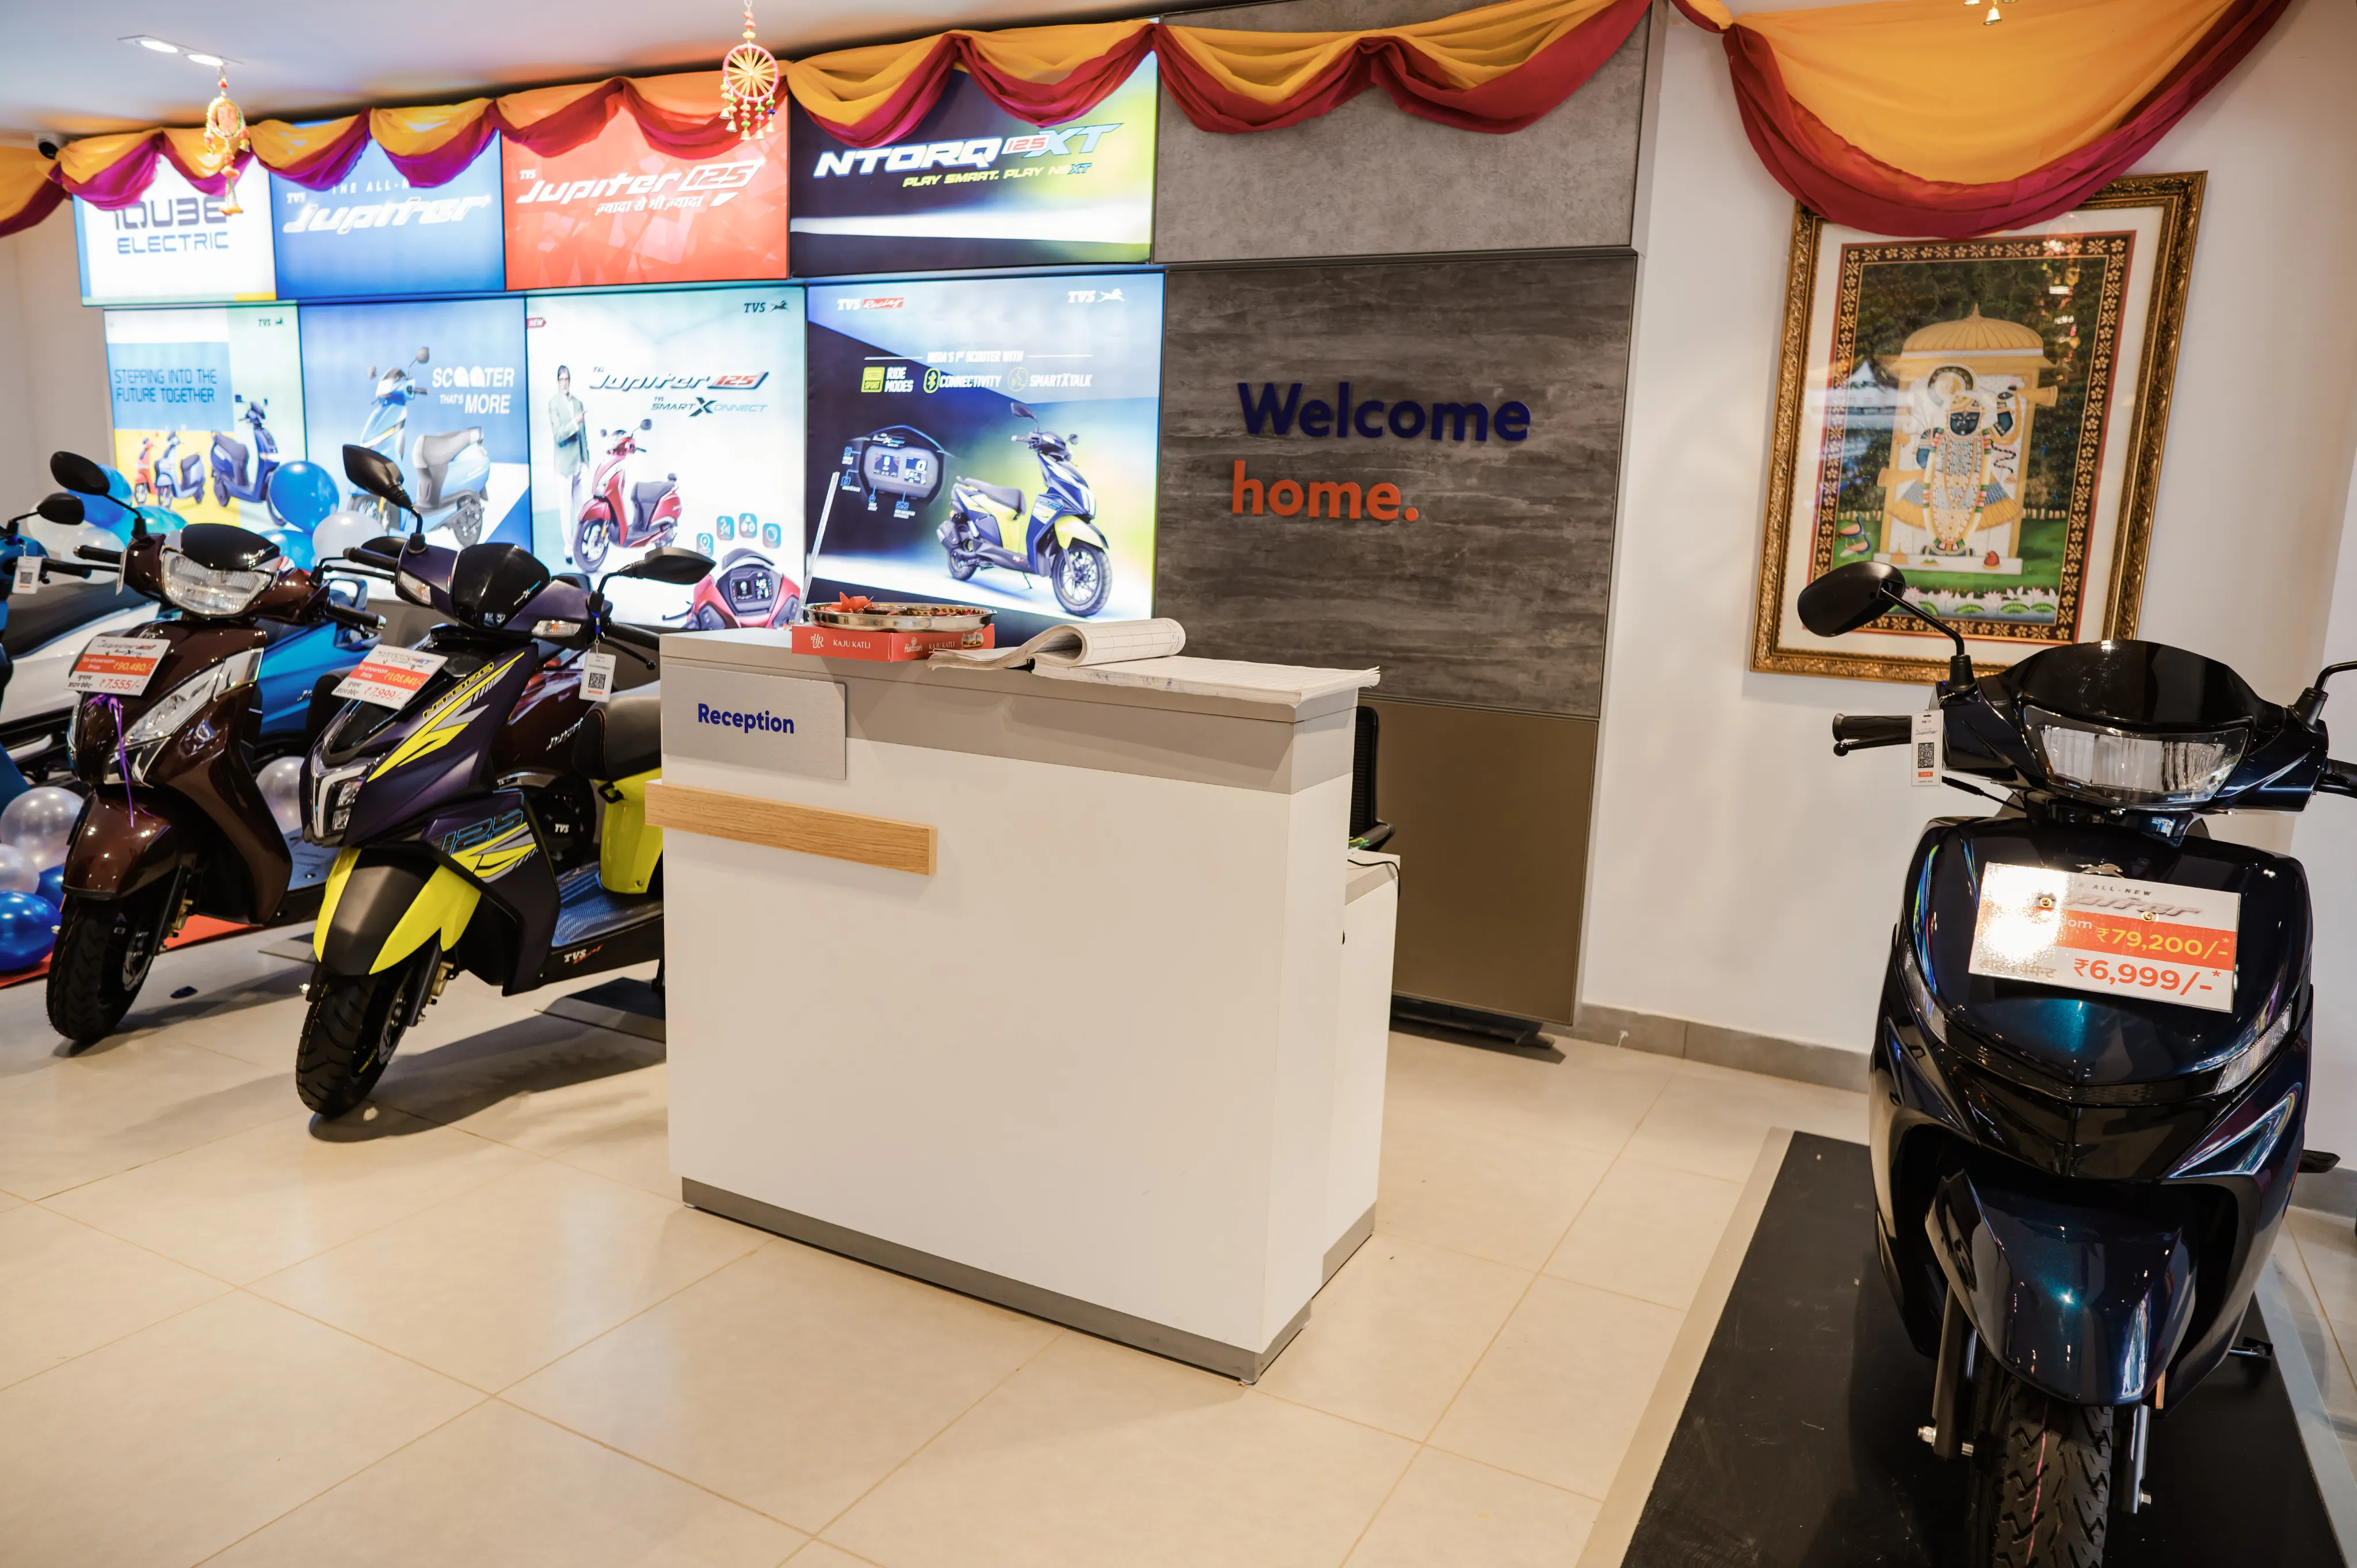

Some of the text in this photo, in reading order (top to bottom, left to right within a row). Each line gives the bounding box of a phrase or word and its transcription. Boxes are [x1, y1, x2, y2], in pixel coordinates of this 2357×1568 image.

[813, 136, 1003, 178] NTORQ
[1006, 138, 1047, 152] 125
[520, 169, 536, 180] TVS
[689, 163, 750, 186] 125
[902, 175, 942, 187] PLAY
[944, 170, 999, 184] SMART.
[1003, 167, 1044, 179] PLAY
[287, 192, 306, 203] TVS
[283, 196, 491, 234] Jupiter
[117, 231, 228, 254] ELECTRIC
[1067, 290, 1096, 303] TVS
[744, 302, 766, 313] TVS
[837, 299, 861, 310] TVS
[258, 319, 270, 327] TVS
[528, 319, 544, 327] NEW
[115, 369, 217, 384] STEPPING INTO THE
[432, 366, 514, 388] SCOOTER
[716, 375, 758, 386] 125
[886, 367, 907, 380] RIDE
[884, 380, 914, 392] MODES
[939, 375, 1002, 388] CONNECTIVITY
[116, 387, 215, 403] FUTURE TOGETHER
[440, 394, 511, 414] THAT'S MORE
[1237, 381, 1531, 441] Welcome
[1231, 460, 1418, 521] home.
[833, 639, 871, 649] KAJU KATLI
[942, 641, 955, 649] KATLI
[422, 662, 494, 720] NTORQ
[697, 703, 794, 734] Reception
[442, 808, 523, 856] 125
[555, 823, 569, 833] TVS
[2092, 884, 2152, 896] ALL-NEW
[2066, 893, 2203, 917] piter
[564, 949, 587, 963] TVS
